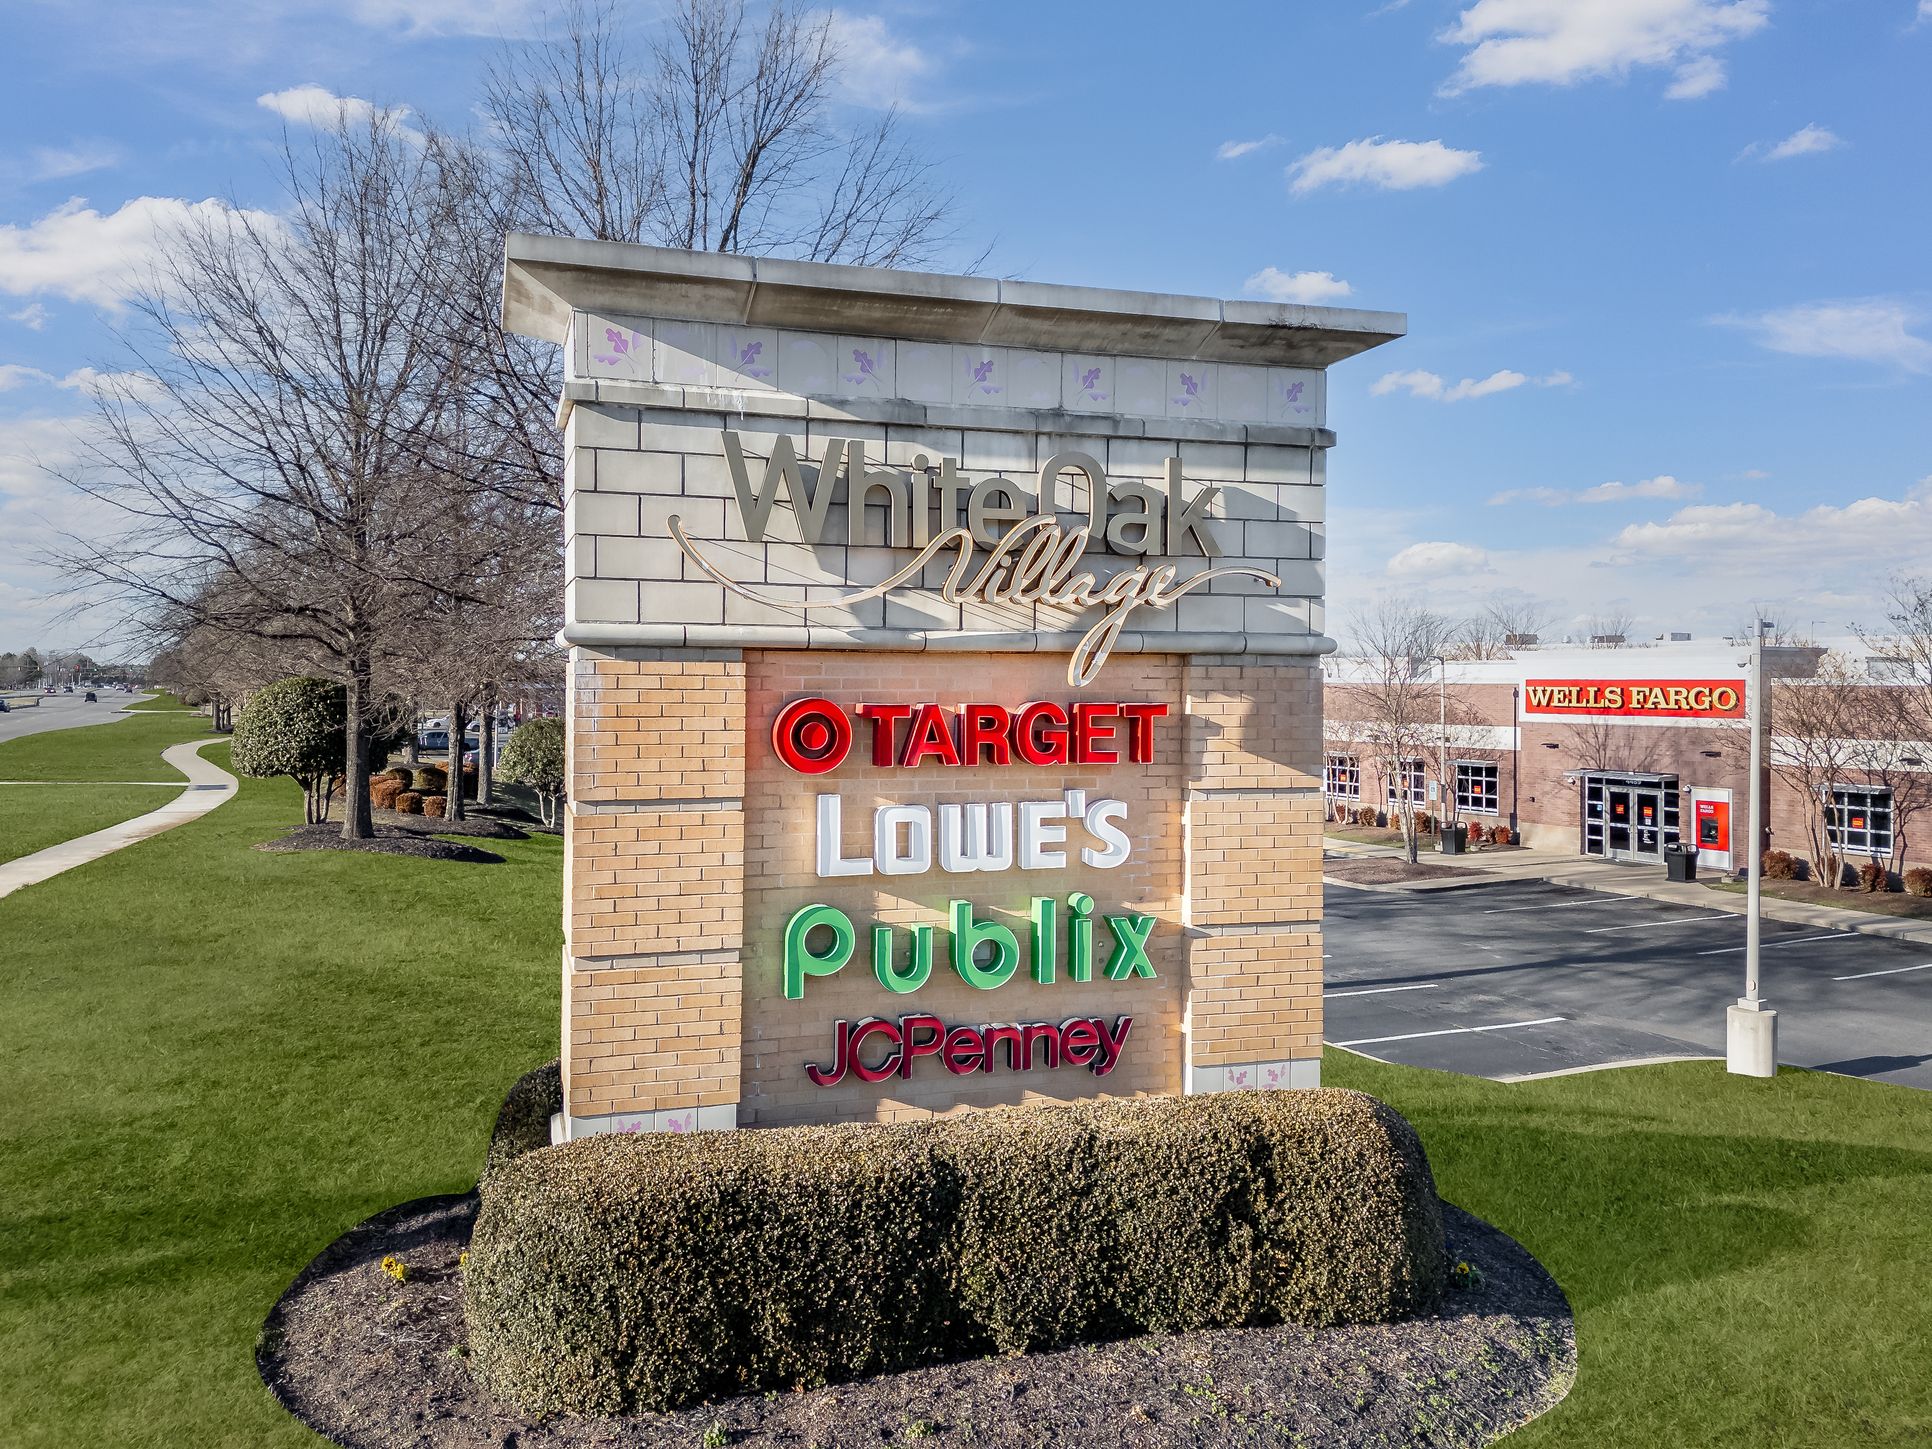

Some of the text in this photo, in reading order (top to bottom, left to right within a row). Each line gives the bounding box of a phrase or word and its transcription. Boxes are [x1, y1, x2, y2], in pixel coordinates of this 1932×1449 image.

[721, 430, 1223, 558] White Oak
[855, 702, 1169, 768] TARGET
[1526, 686, 1738, 711] WELLS FARGO
[815, 789, 1131, 877] LOWE'S
[804, 1013, 1134, 1087] JCPenney
